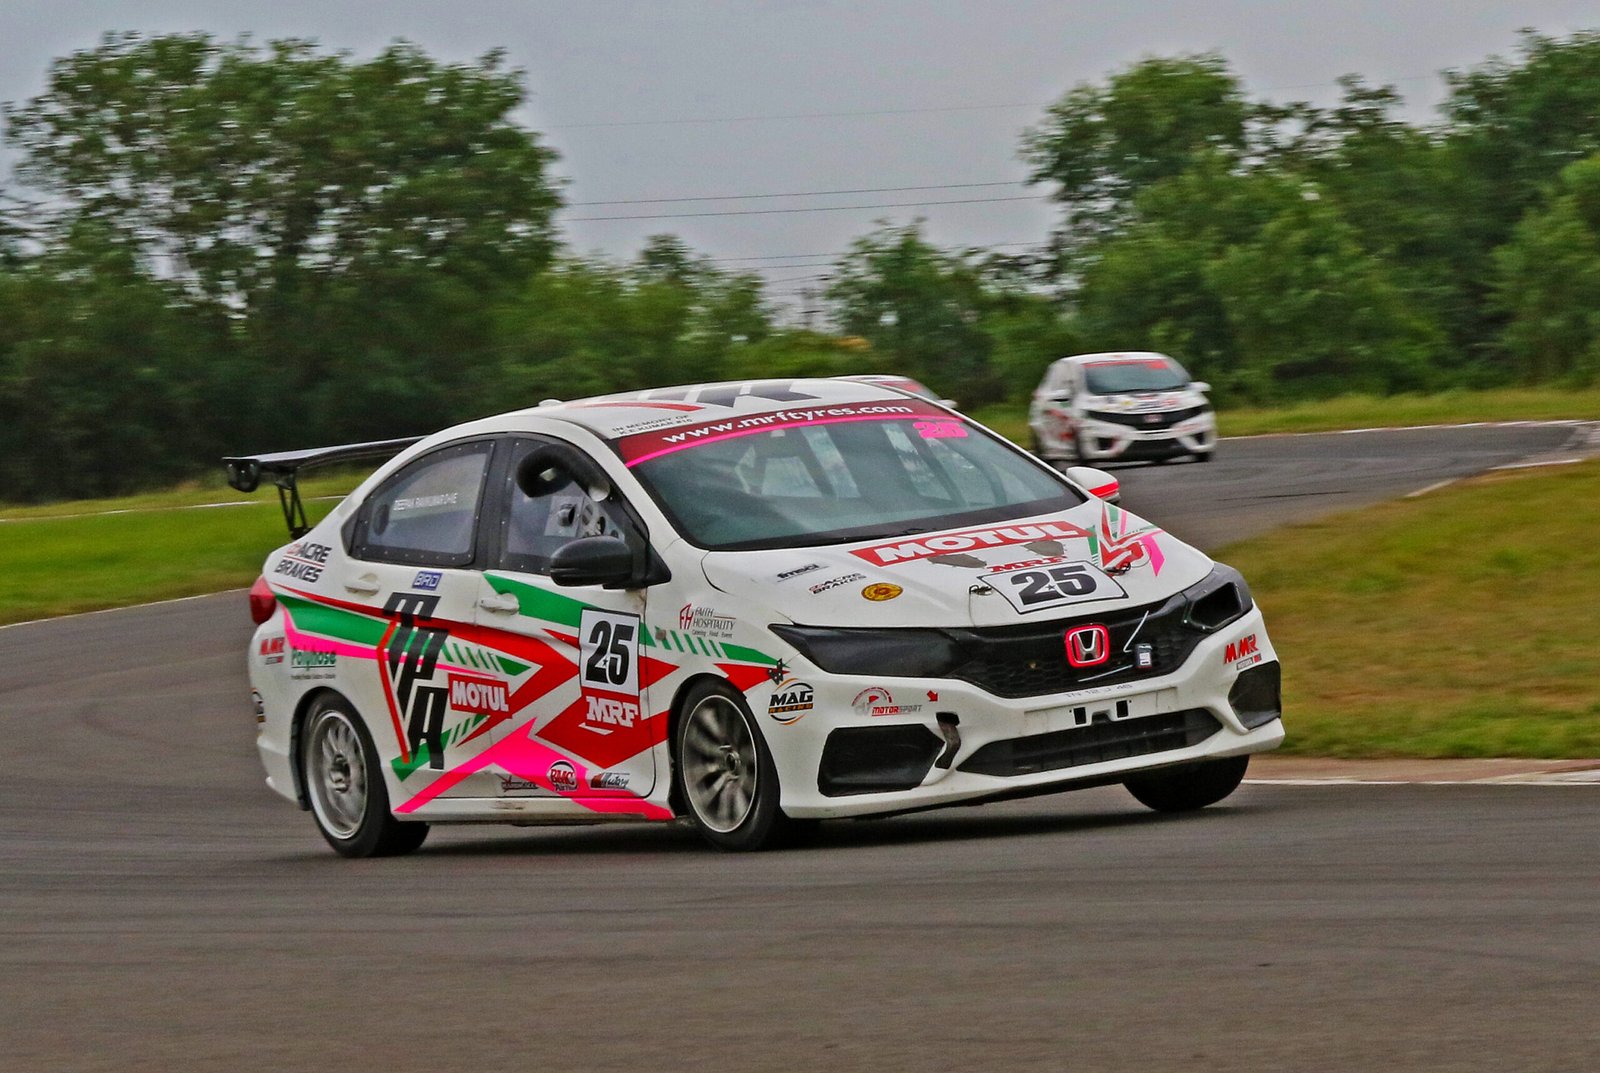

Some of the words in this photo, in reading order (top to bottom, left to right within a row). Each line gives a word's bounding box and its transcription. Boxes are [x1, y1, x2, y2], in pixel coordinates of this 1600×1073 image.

[662, 404, 913, 443] www.mrftyres.com
[874, 524, 1077, 562] MOTUL
[274, 559, 323, 583] BRAKES
[985, 556, 1069, 573] MRF
[812, 576, 867, 595] BRAKES
[1010, 565, 1098, 606] 25
[693, 618, 736, 630] HOSPITALITY
[585, 620, 635, 686] 25
[452, 680, 509, 712] MOTUL
[769, 690, 813, 706] MAG
[586, 695, 638, 728] MRF
[872, 704, 922, 715] MOTORSPORT
[550, 769, 575, 786] BMC
